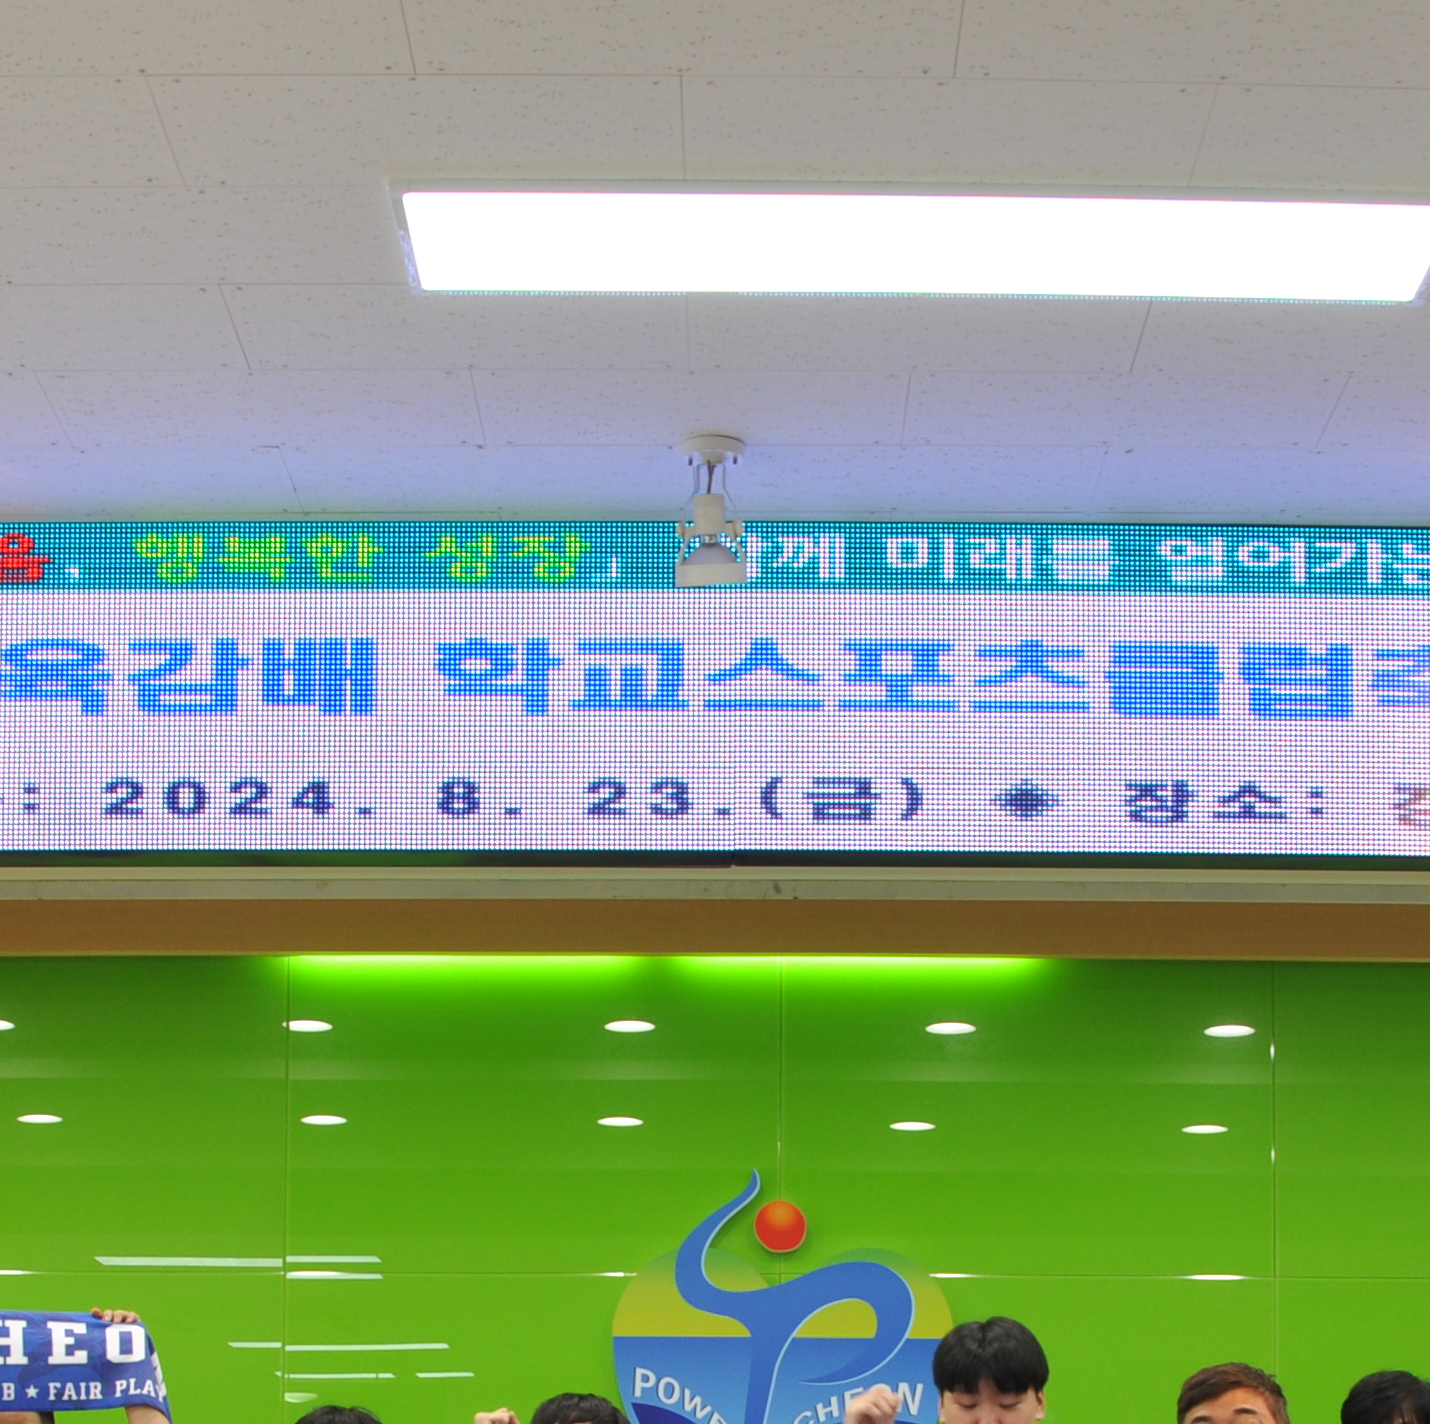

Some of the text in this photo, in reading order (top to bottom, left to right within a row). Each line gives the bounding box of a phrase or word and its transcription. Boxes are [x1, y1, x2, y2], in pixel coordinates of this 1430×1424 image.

[130, 529, 383, 585] 행복한
[886, 532, 1121, 584] 미래를
[101, 776, 373, 819] 2024.
[436, 776, 522, 819] 8.
[1124, 780, 1325, 827] 장소:
[48, 1380, 103, 1401] FAIR
